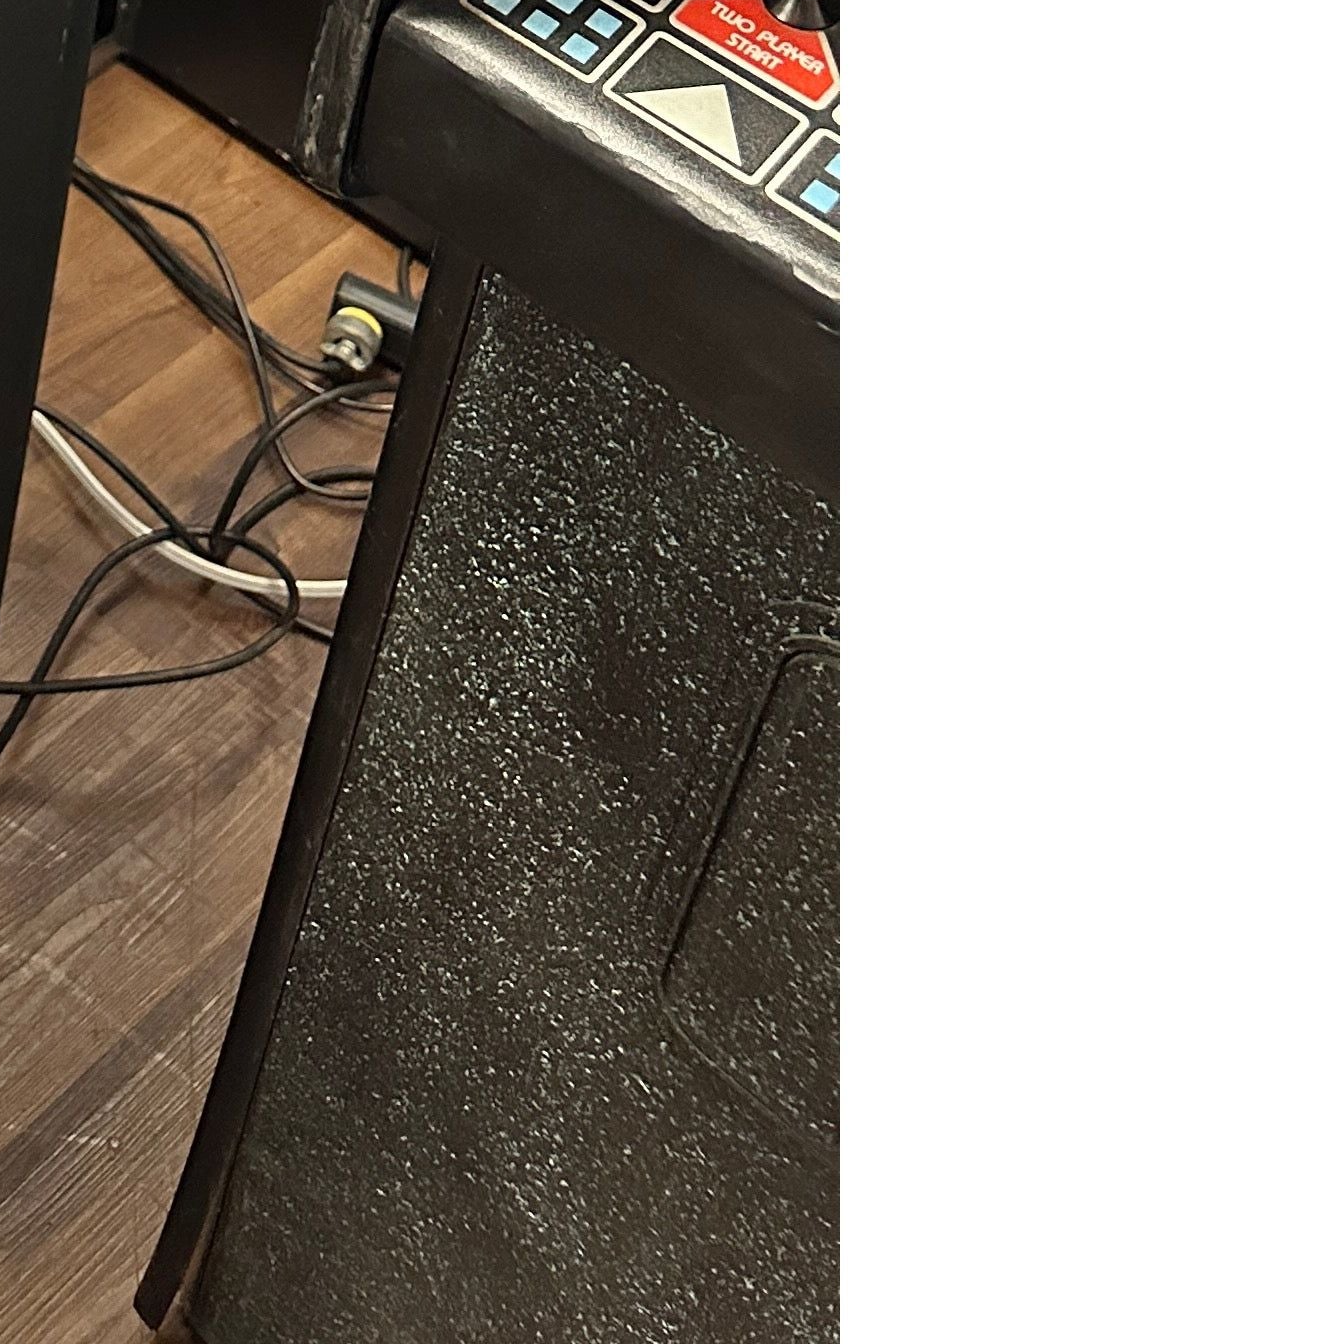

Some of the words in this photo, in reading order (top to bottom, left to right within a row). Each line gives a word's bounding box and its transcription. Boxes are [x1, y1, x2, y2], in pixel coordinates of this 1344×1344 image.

[711, 0, 756, 34] TWO
[756, 30, 825, 76] PLAYER
[724, 32, 784, 70] START
